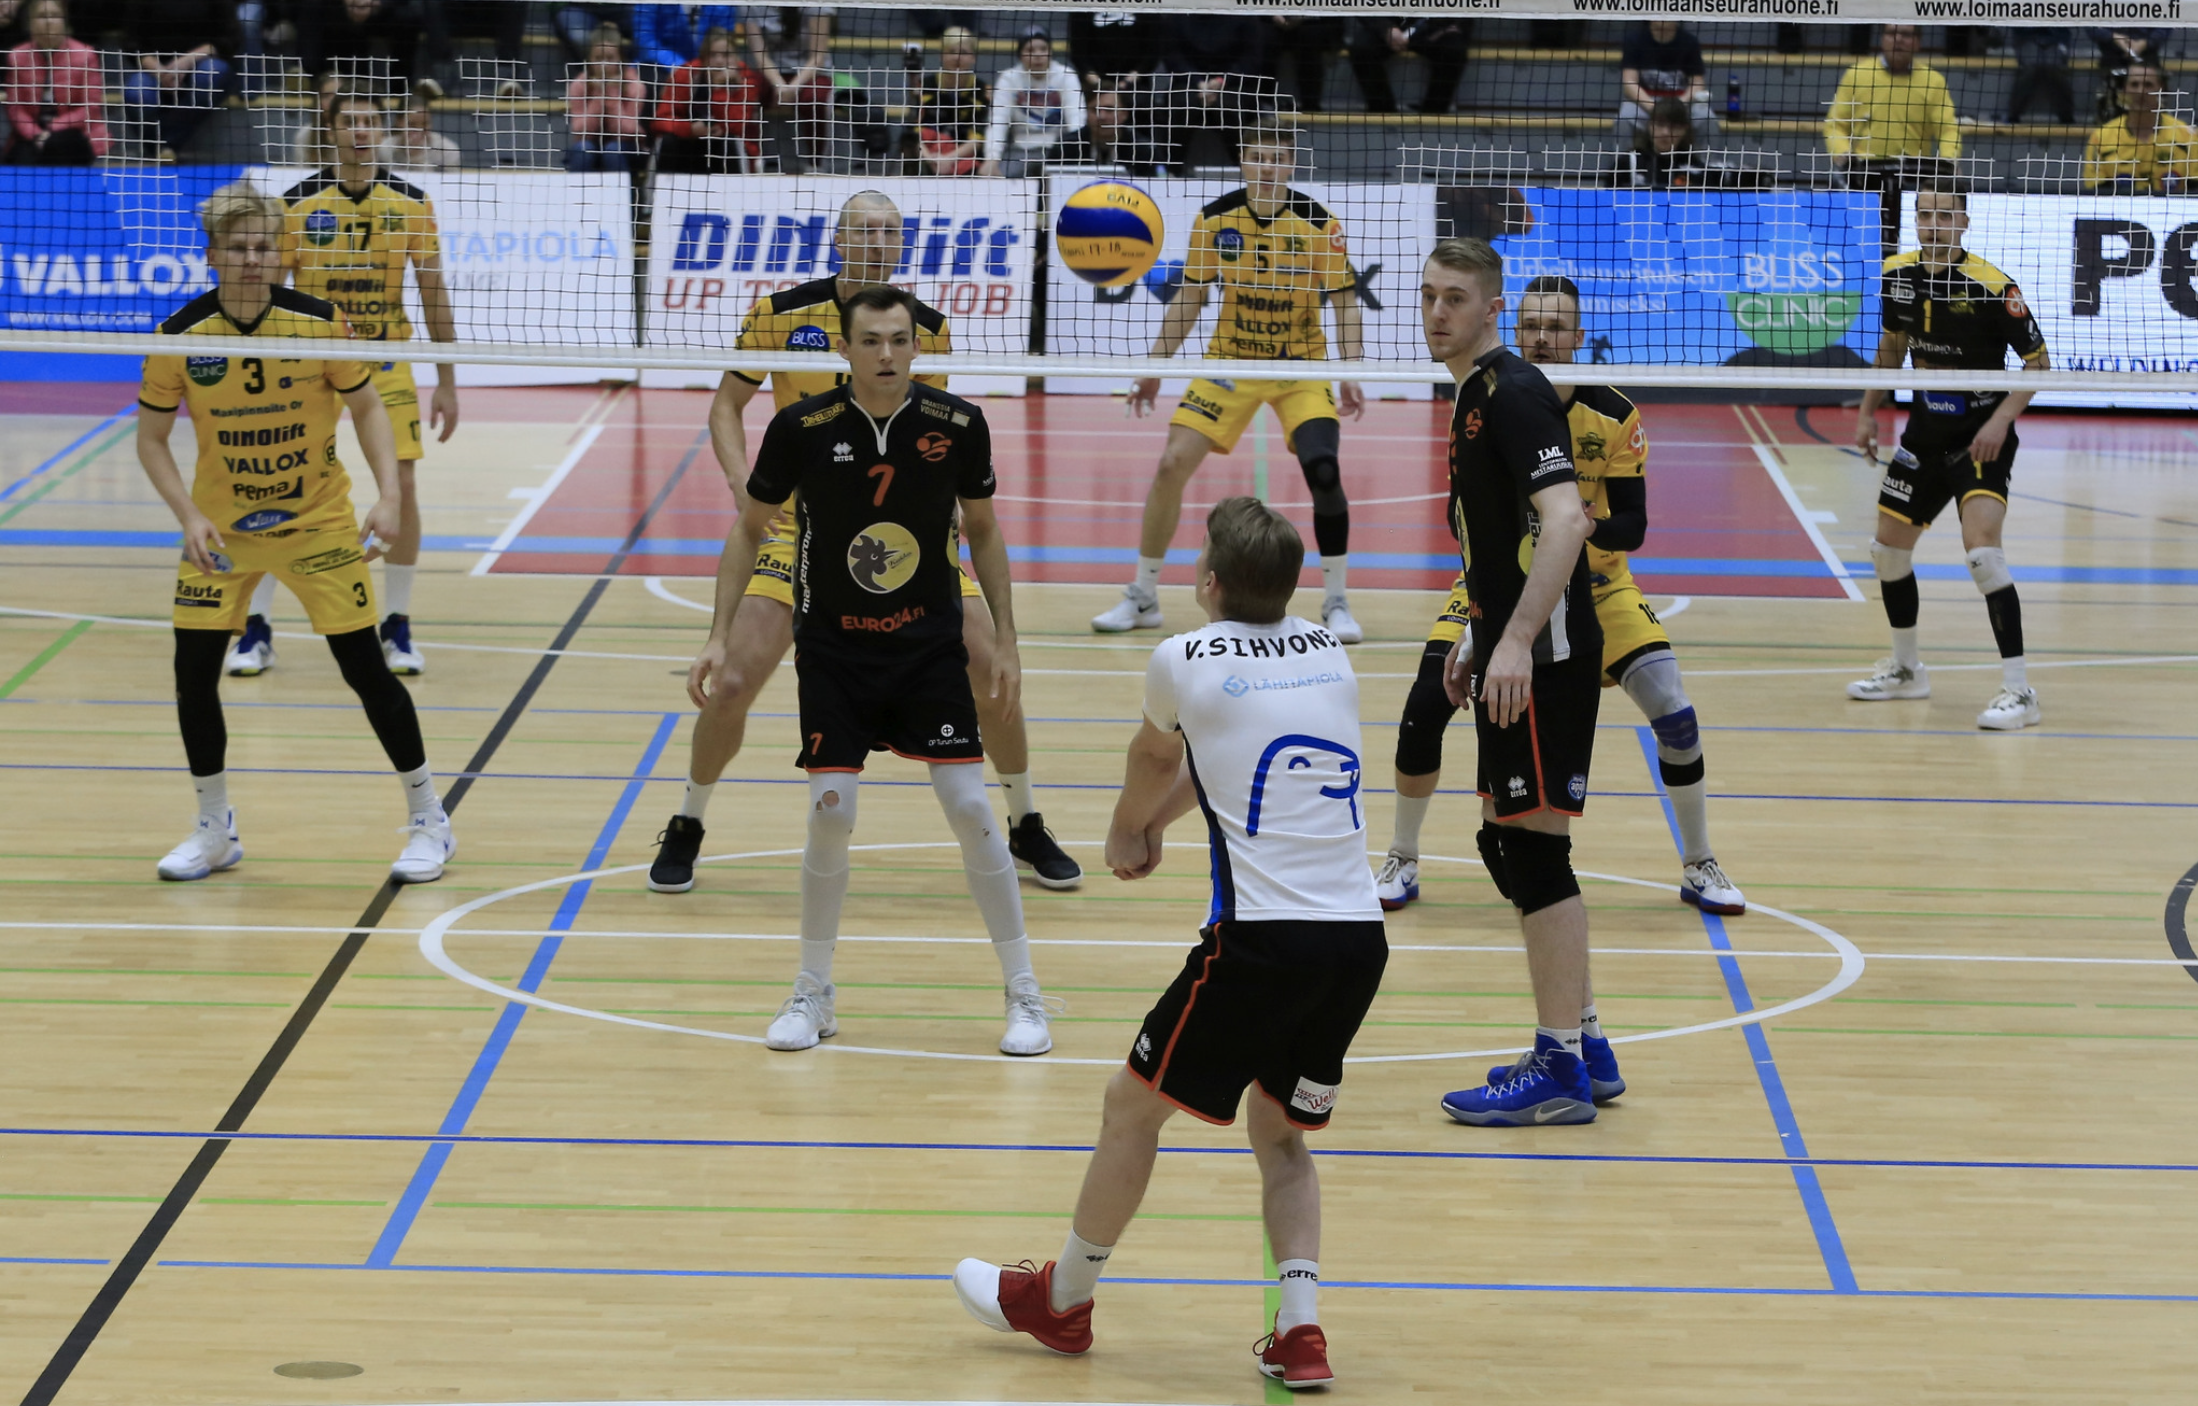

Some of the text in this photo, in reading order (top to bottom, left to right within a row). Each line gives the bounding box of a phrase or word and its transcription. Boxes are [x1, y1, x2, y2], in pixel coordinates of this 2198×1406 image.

[1916, 0, 2180, 18] www.loimaanseurahuone.fi
[344, 222, 372, 252] 17
[442, 230, 619, 262] TAPIOLA
[672, 213, 1020, 277] DINlift
[1254, 244, 1270, 275] 5
[1744, 251, 1844, 289] BLISS
[12, 253, 217, 296] VALLOX
[663, 278, 724, 309] UP
[1736, 297, 1849, 328] CLINIC
[1923, 299, 1932, 333] 1
[791, 332, 826, 348] BLISS
[188, 364, 226, 378] CLINIC
[242, 357, 266, 395] 3
[919, 404, 949, 421] VOIMAA
[217, 422, 307, 448] DINOlift
[222, 448, 310, 476] VALLOX
[1537, 445, 1564, 462] LML
[1974, 460, 1983, 480] 1
[233, 480, 289, 501] Pema
[867, 463, 895, 507] 7
[1882, 474, 1914, 496] auta
[757, 554, 791, 573] Rau
[176, 579, 223, 600] Rauta
[352, 581, 369, 608] 3
[841, 605, 926, 633] EURO24.FI
[1185, 628, 1342, 661] V.SIHVONE
[810, 731, 823, 756] 7
[1286, 1269, 1318, 1282] erre
